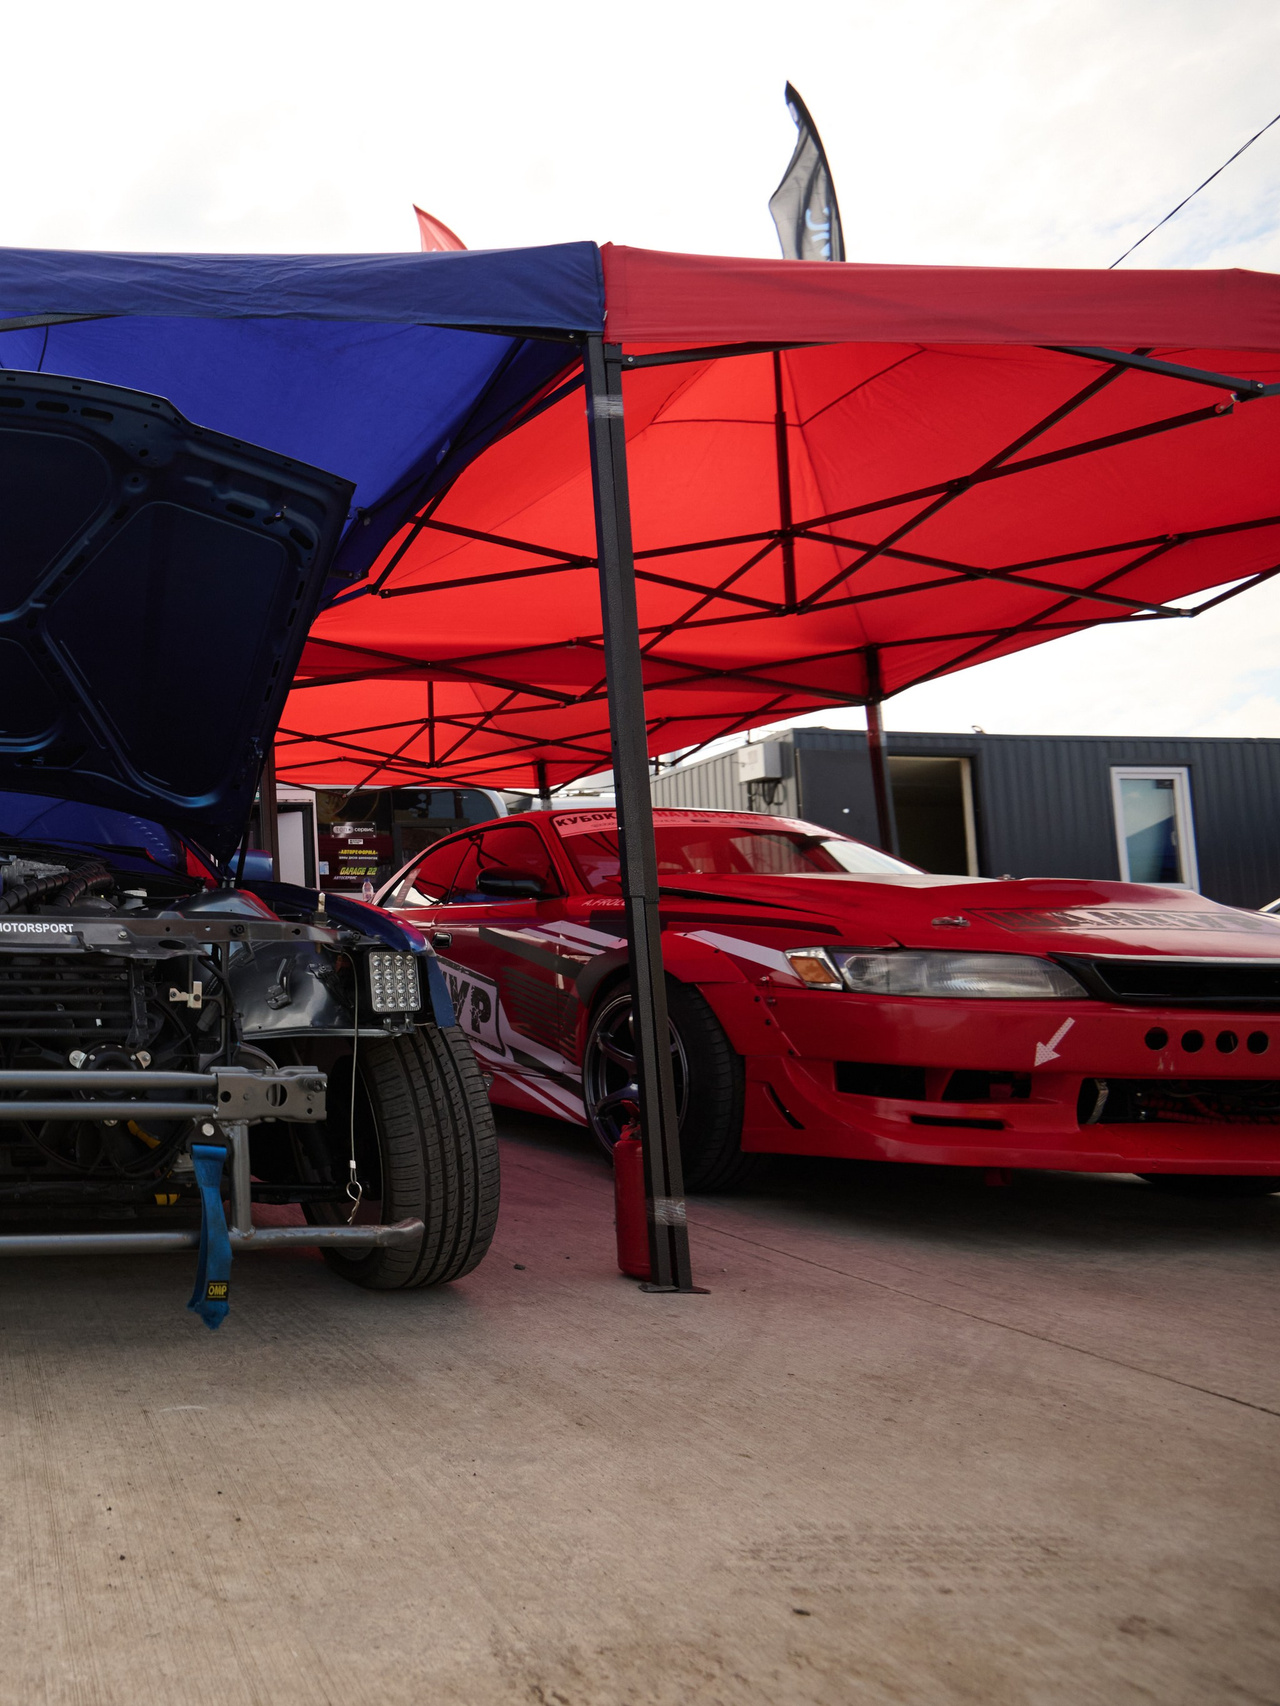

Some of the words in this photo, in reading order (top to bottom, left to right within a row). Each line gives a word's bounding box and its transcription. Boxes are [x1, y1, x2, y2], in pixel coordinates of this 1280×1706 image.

[555, 813, 616, 826] КУБОК
[367, 867, 378, 876] 22
[208, 1285, 227, 1296] OMP
